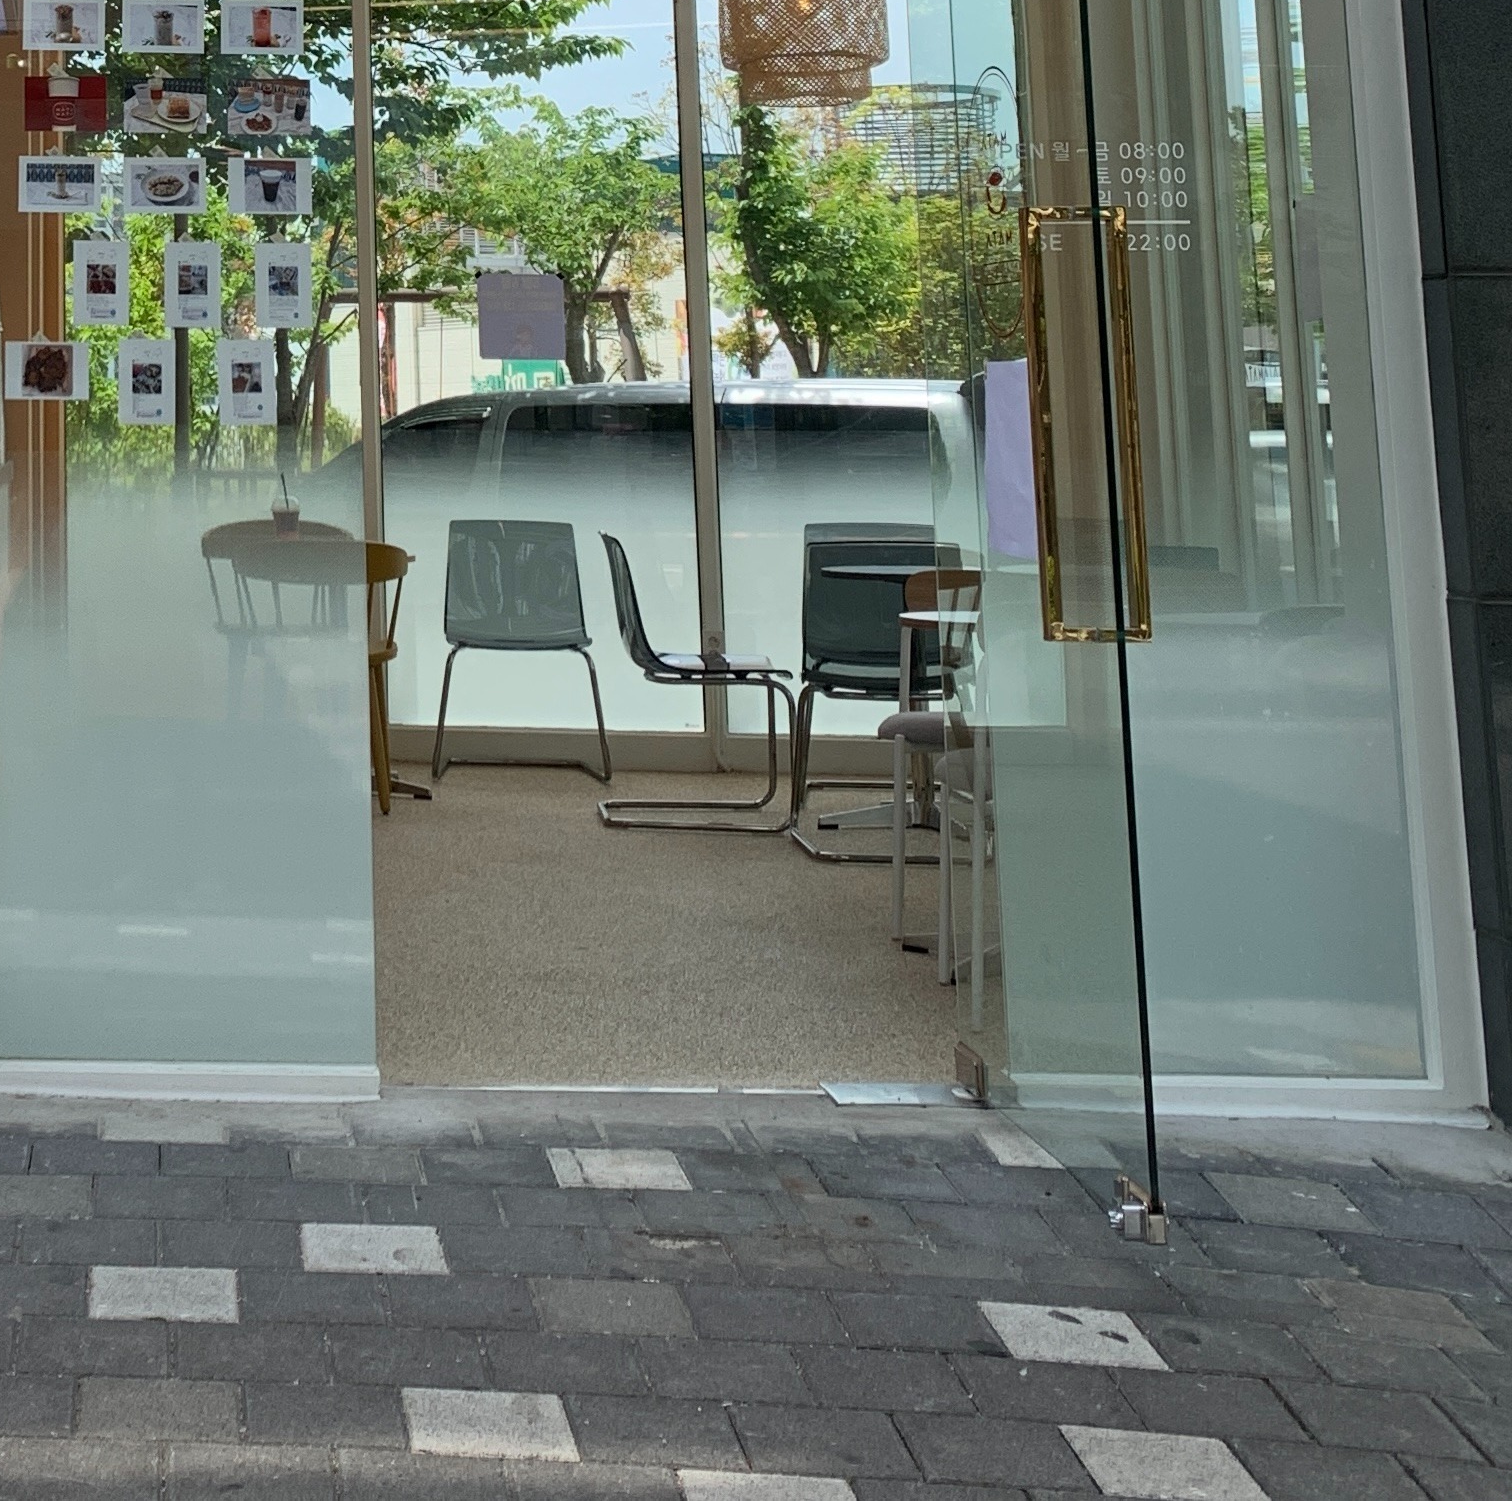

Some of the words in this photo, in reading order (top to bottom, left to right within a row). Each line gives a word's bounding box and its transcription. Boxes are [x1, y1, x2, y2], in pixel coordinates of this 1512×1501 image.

[999, 143, 1045, 159] PEN
[1119, 142, 1185, 159] 08:00
[1121, 167, 1186, 184] 09:00
[1124, 191, 1188, 208] 10:00
[1128, 234, 1191, 251] 22:00
